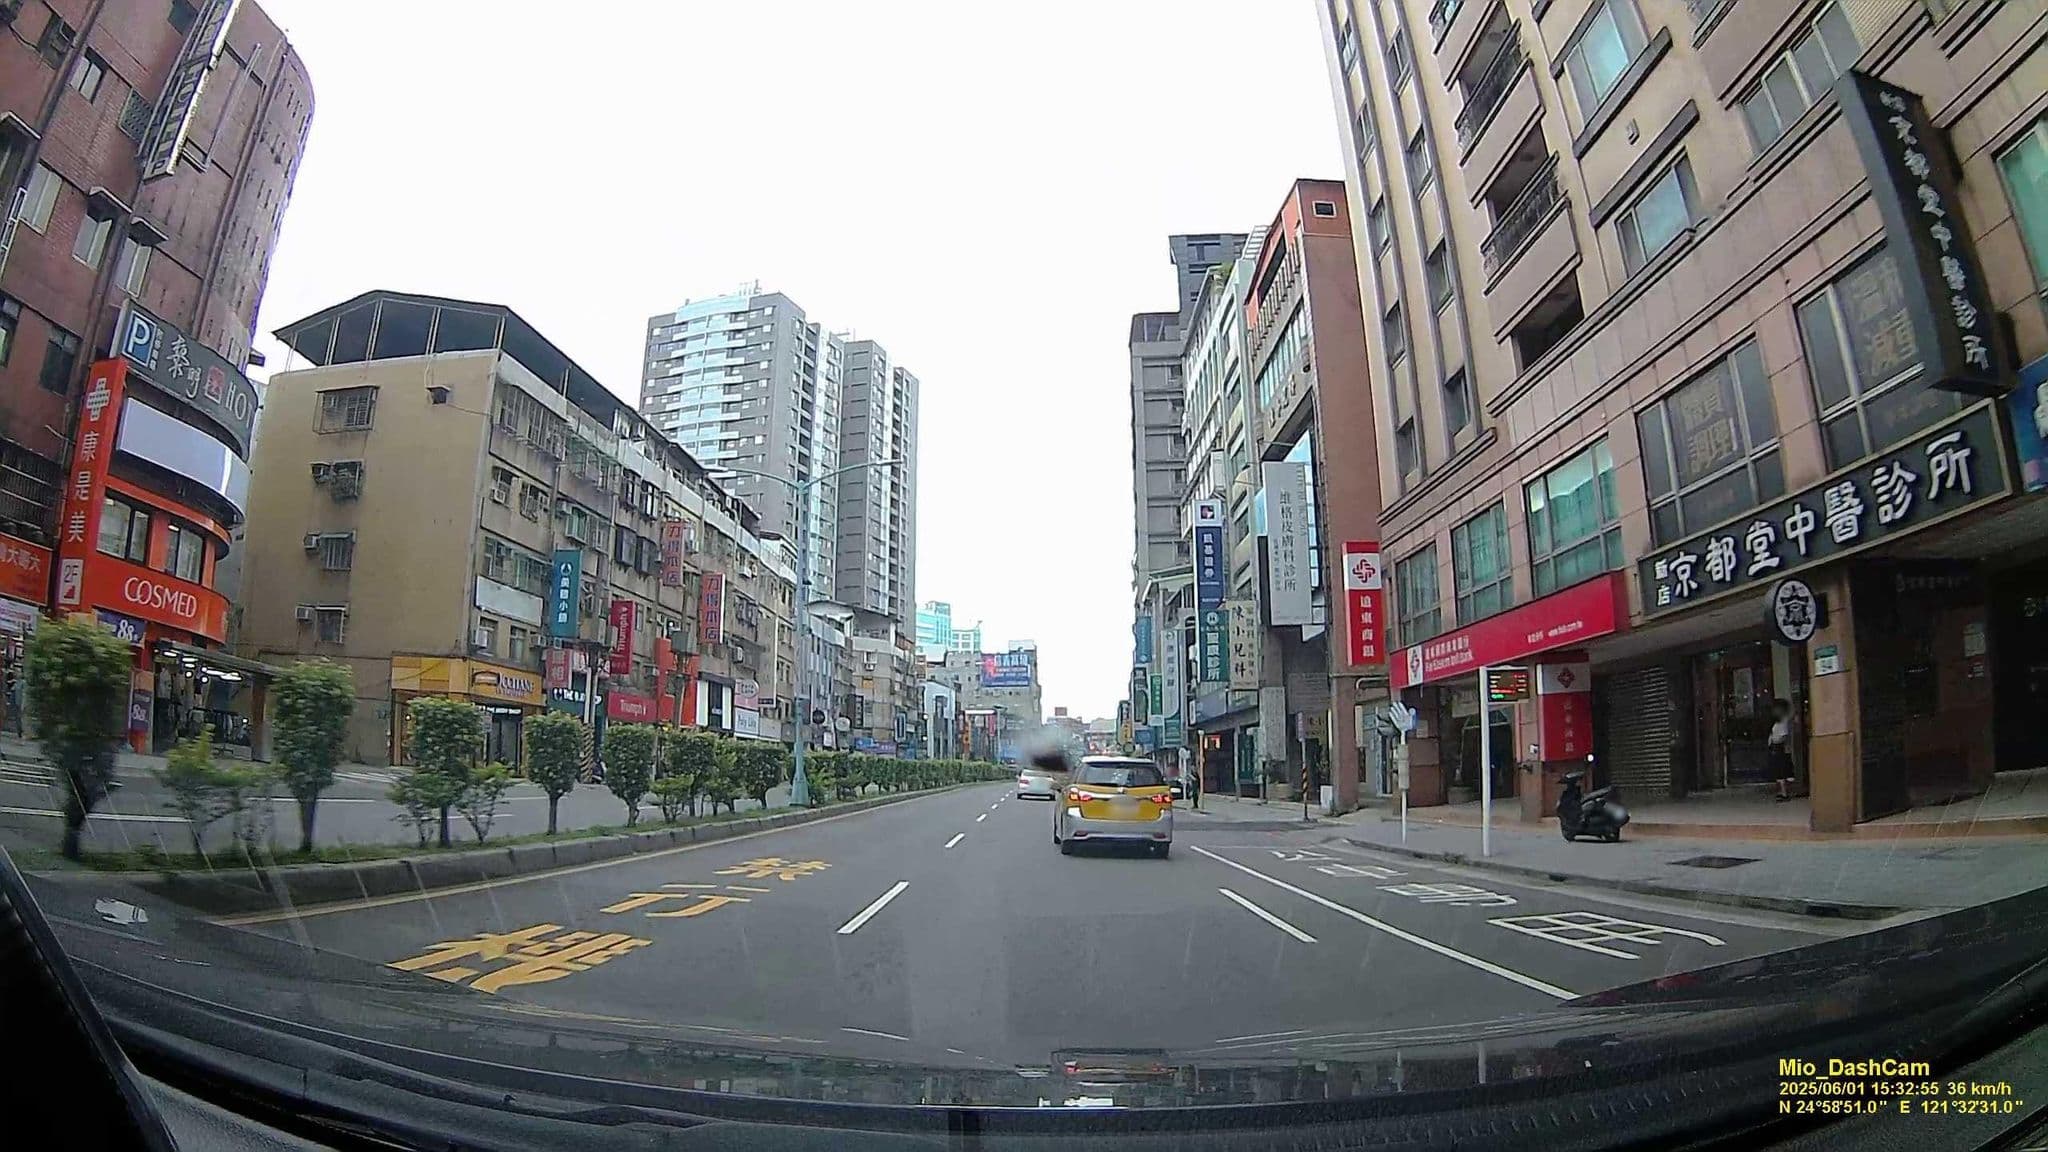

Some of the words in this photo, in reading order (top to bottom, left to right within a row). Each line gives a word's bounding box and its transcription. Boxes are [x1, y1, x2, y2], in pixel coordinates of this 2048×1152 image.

[1888, 115, 1989, 371] 京都堂中醫診所
[128, 316, 149, 353] P
[68, 431, 99, 543] 康是美
[1669, 431, 1971, 598] 京都堂中醫診所
[64, 564, 79, 583] 2F
[124, 576, 197, 618] COSMED
